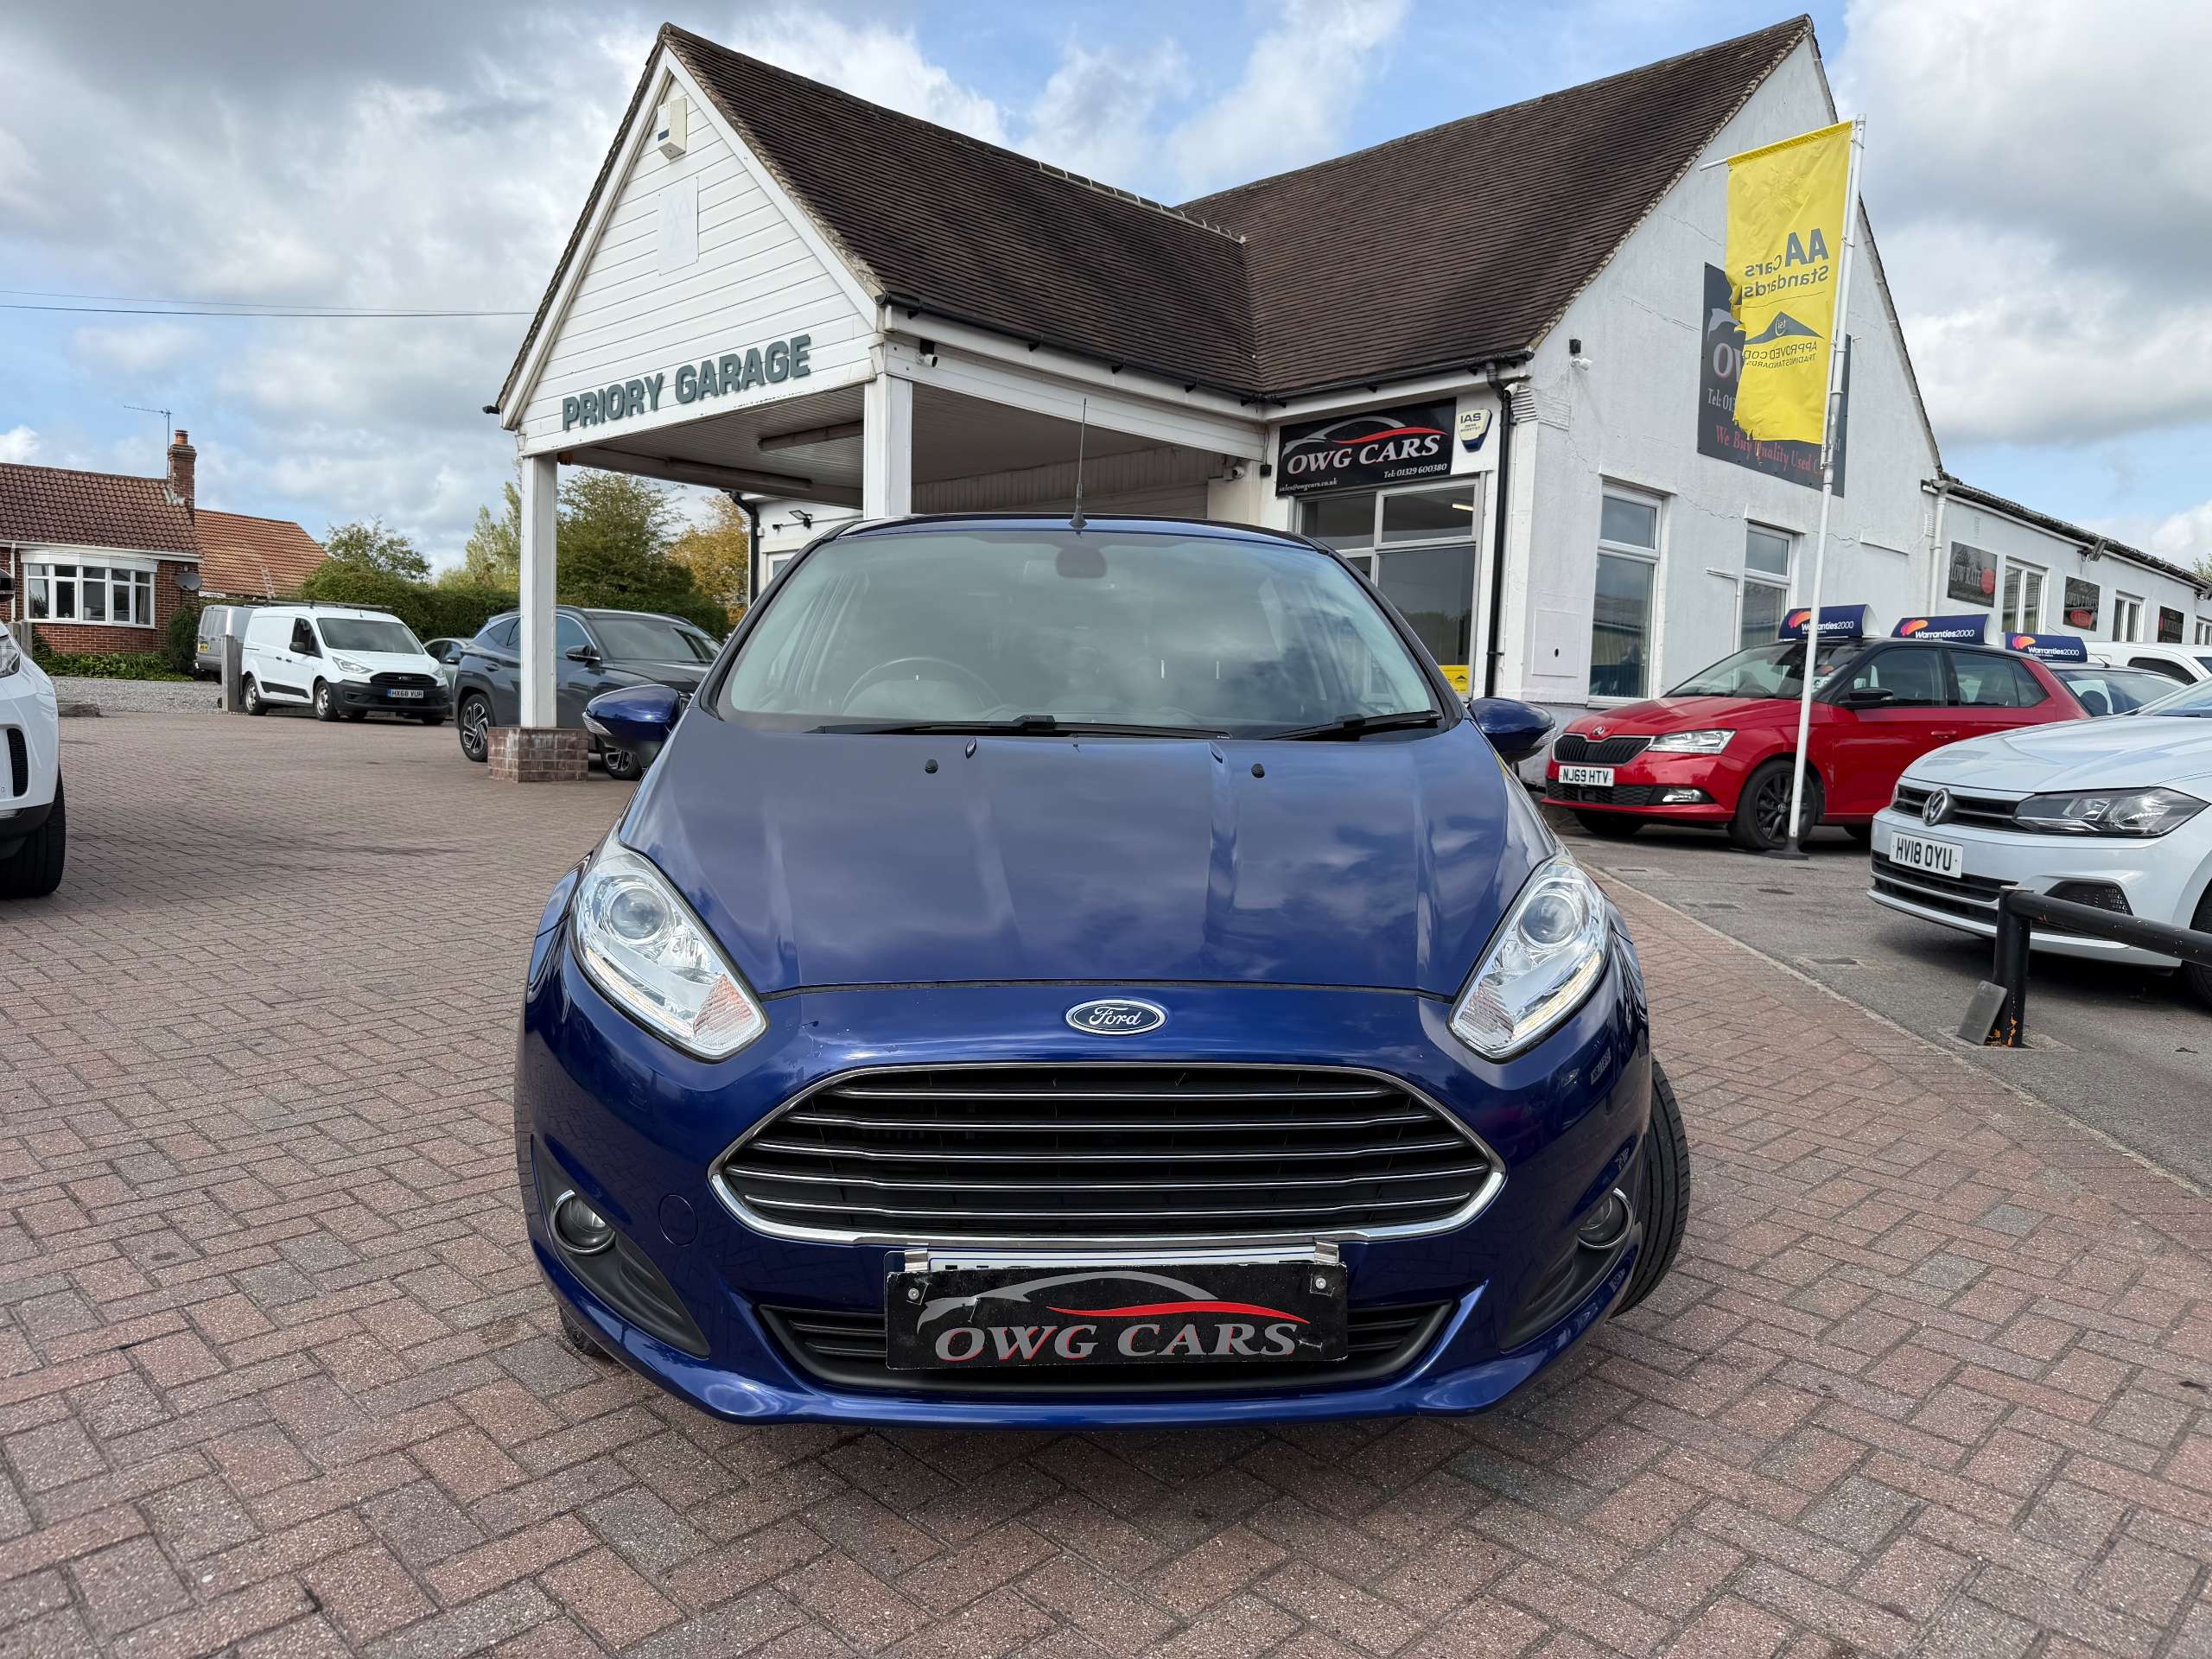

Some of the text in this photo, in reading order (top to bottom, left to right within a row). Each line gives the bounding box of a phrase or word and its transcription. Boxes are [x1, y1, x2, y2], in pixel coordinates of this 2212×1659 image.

[562, 334, 811, 432] PRIORY GARAGE
[1460, 413, 1481, 423] IAS
[1287, 435, 1440, 474] OWG CARS
[1715, 425, 1729, 446] We
[1791, 449, 1811, 471] Used
[1384, 462, 1447, 479] Tel: 01329 600380
[1802, 621, 1854, 632] Wanties2000
[1915, 629, 1975, 639] Warranties2000
[2027, 645, 2080, 656] Warranties2000
[1562, 768, 1609, 784] NJ69 HTV
[1897, 837, 1952, 871] HV18 OYU
[1089, 1006, 1142, 1026] Ford
[935, 1323, 1299, 1360] OWG CARS
